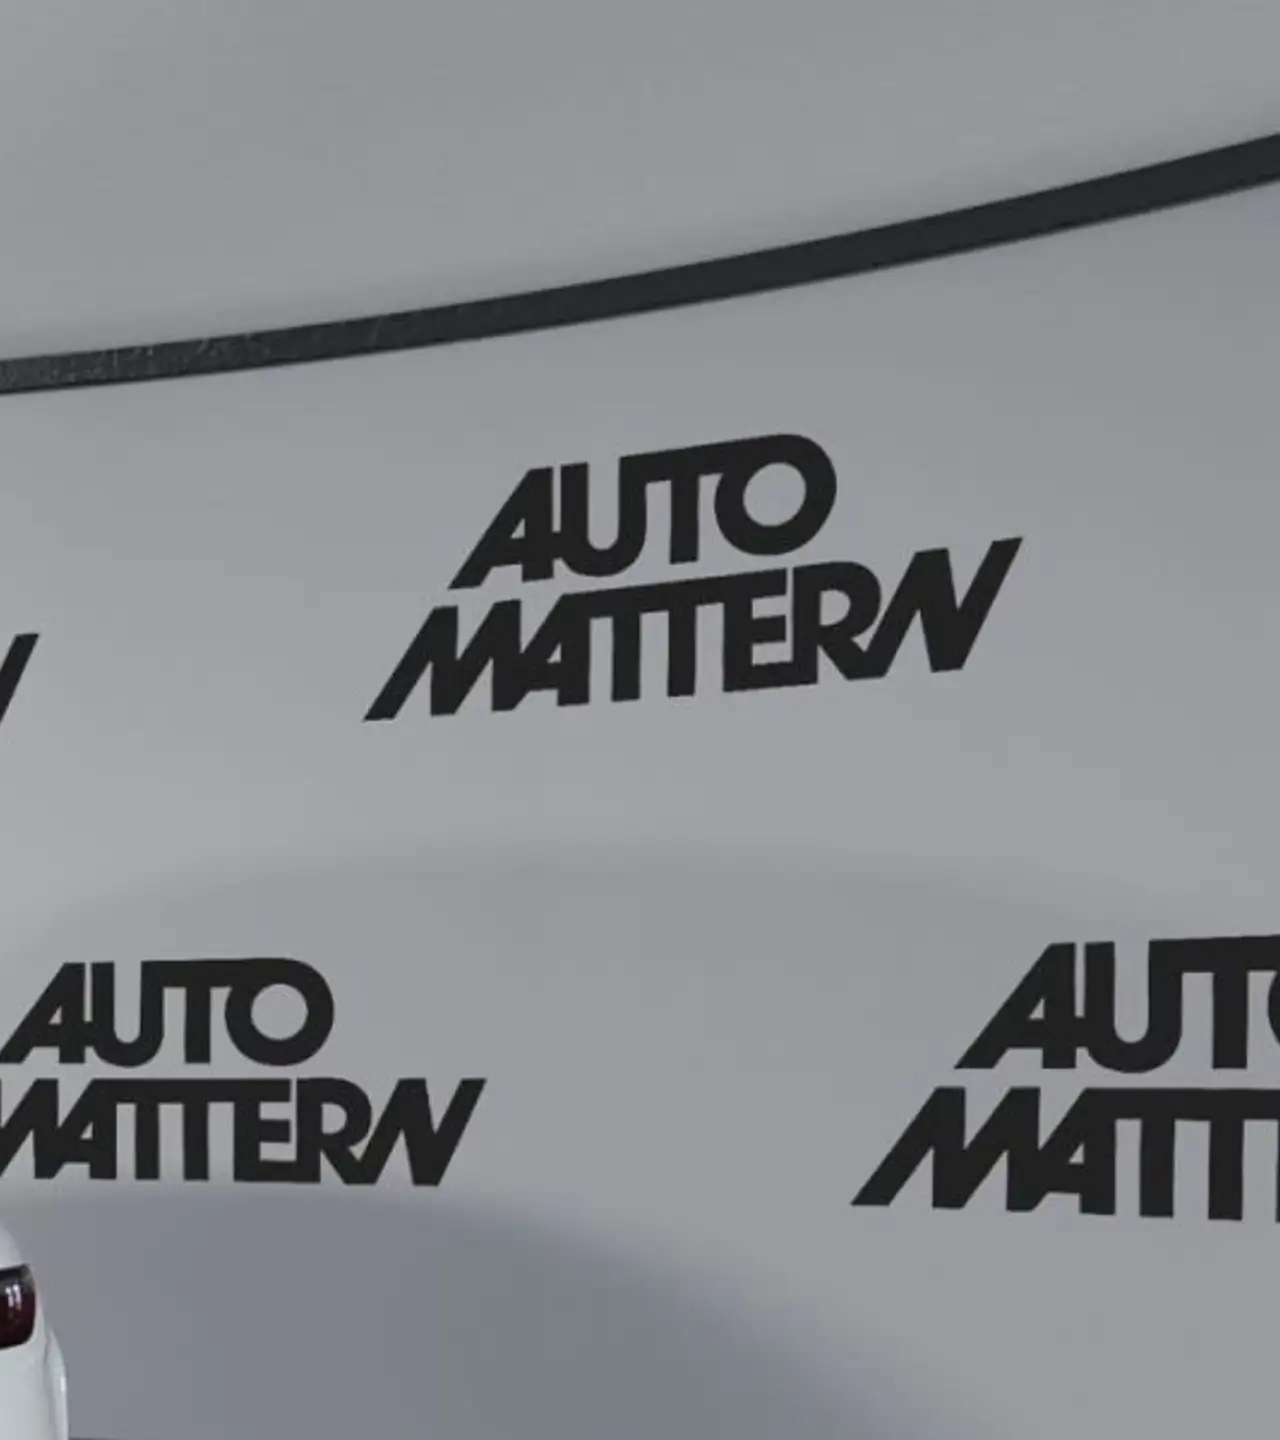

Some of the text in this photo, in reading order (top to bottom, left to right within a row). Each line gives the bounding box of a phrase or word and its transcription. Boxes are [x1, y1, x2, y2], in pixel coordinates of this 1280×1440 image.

[449, 434, 836, 589] AUTO
[365, 538, 1022, 720] MATTERN
[954, 935, 1280, 1073] AUT
[852, 1087, 1280, 1222] MATT
